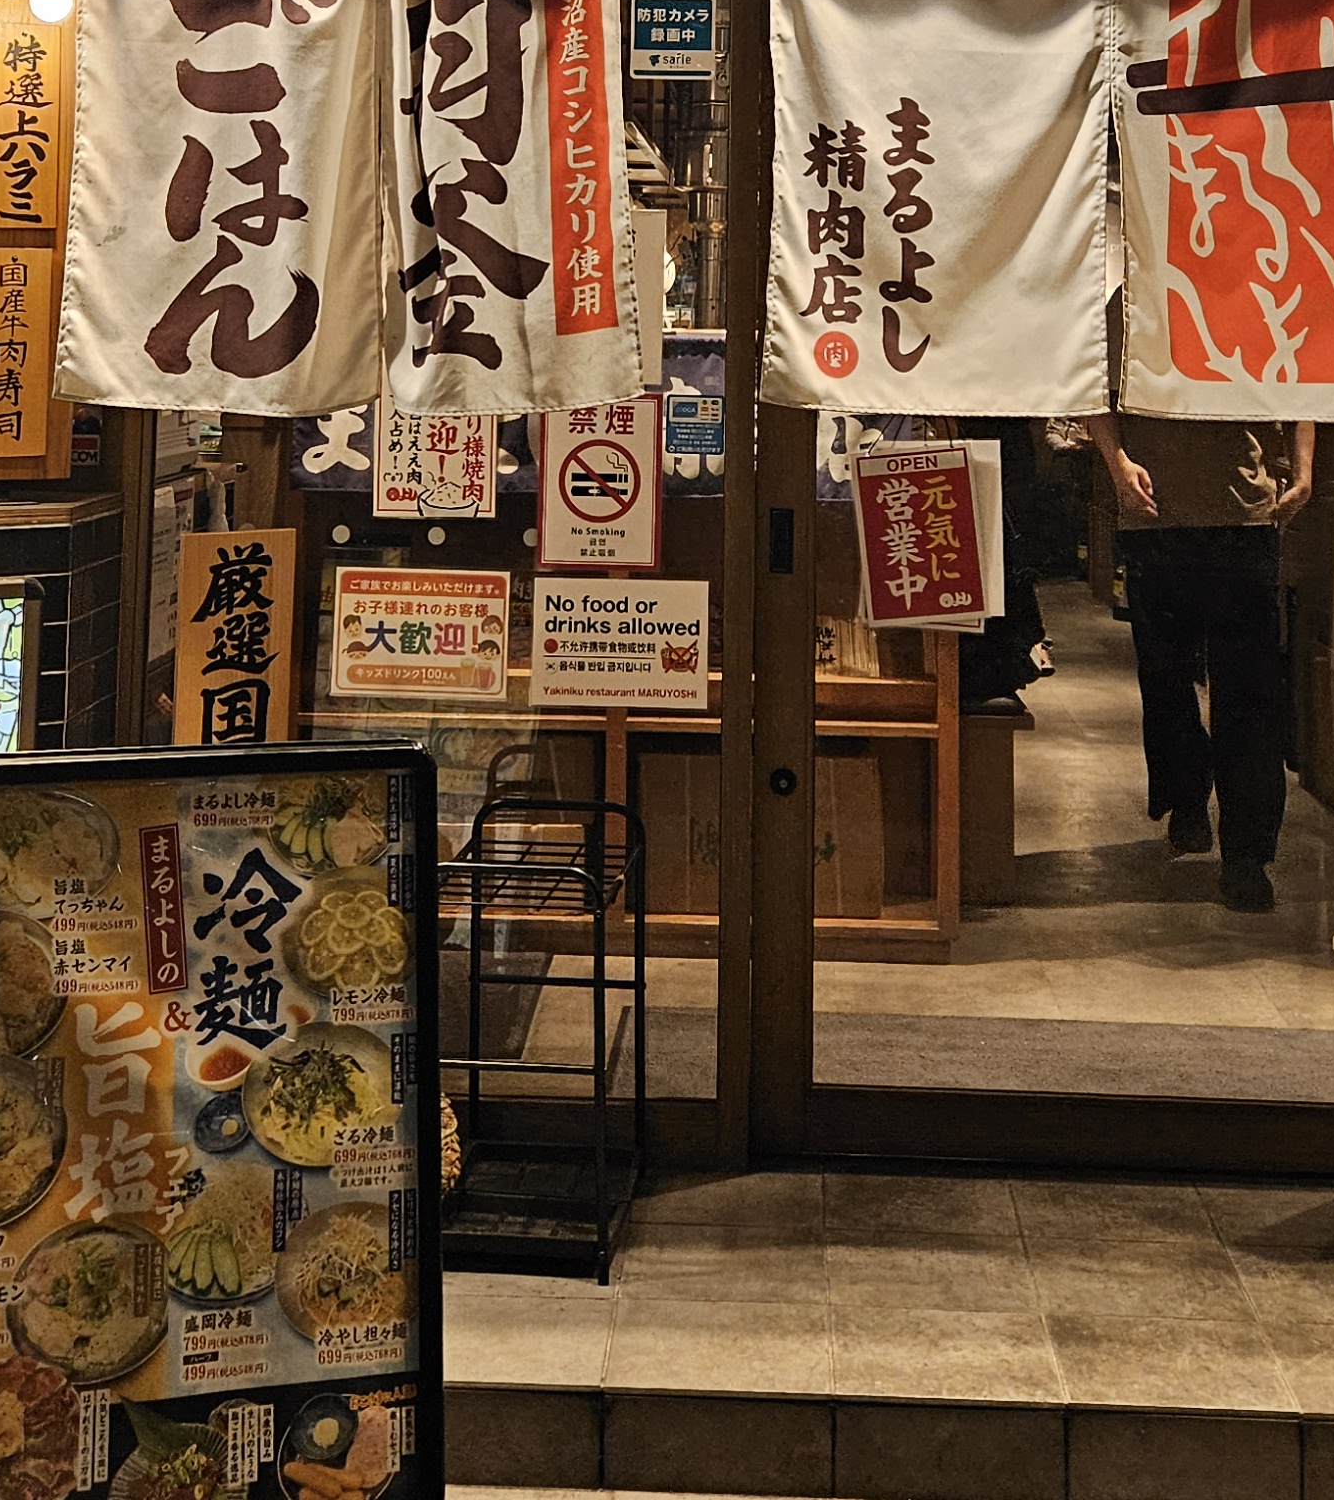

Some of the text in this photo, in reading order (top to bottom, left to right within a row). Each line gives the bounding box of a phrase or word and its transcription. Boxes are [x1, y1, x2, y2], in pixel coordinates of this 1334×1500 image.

[637, 8, 709, 22] 防犯カメラ
[651, 28, 695, 43] 録画中
[799, 121, 866, 324] 精肉店
[879, 98, 934, 372] まるよし
[569, 406, 635, 434] 禁煙
[887, 454, 937, 471] OPEN
[571, 527, 625, 538] No Smoking
[921, 475, 960, 581] 元気に
[876, 479, 928, 610] 営業中
[354, 600, 489, 618] お子様連れのお客様
[545, 595, 657, 614] No food or
[545, 616, 700, 635] drinks allowed
[543, 686, 697, 698] Yakiniku restaurant MARUYOSHI
[193, 792, 275, 810] まるよし冷麺
[54, 879, 85, 895] 旨塩
[55, 896, 123, 914] てっちゃん
[150, 835, 180, 984] まるよしの
[54, 939, 86, 955] 旨塩
[194, 847, 302, 1050] 冷麺
[54, 956, 131, 975] 赤センマイ
[332, 986, 405, 1005] レモン冷麺
[165, 1002, 191, 1033] &
[64, 1002, 161, 1223] 旨塩
[334, 1126, 394, 1146] ざる冷麺
[184, 1311, 252, 1332] 盛岡冷麺
[318, 1323, 407, 1346] 冷やし担々麺
